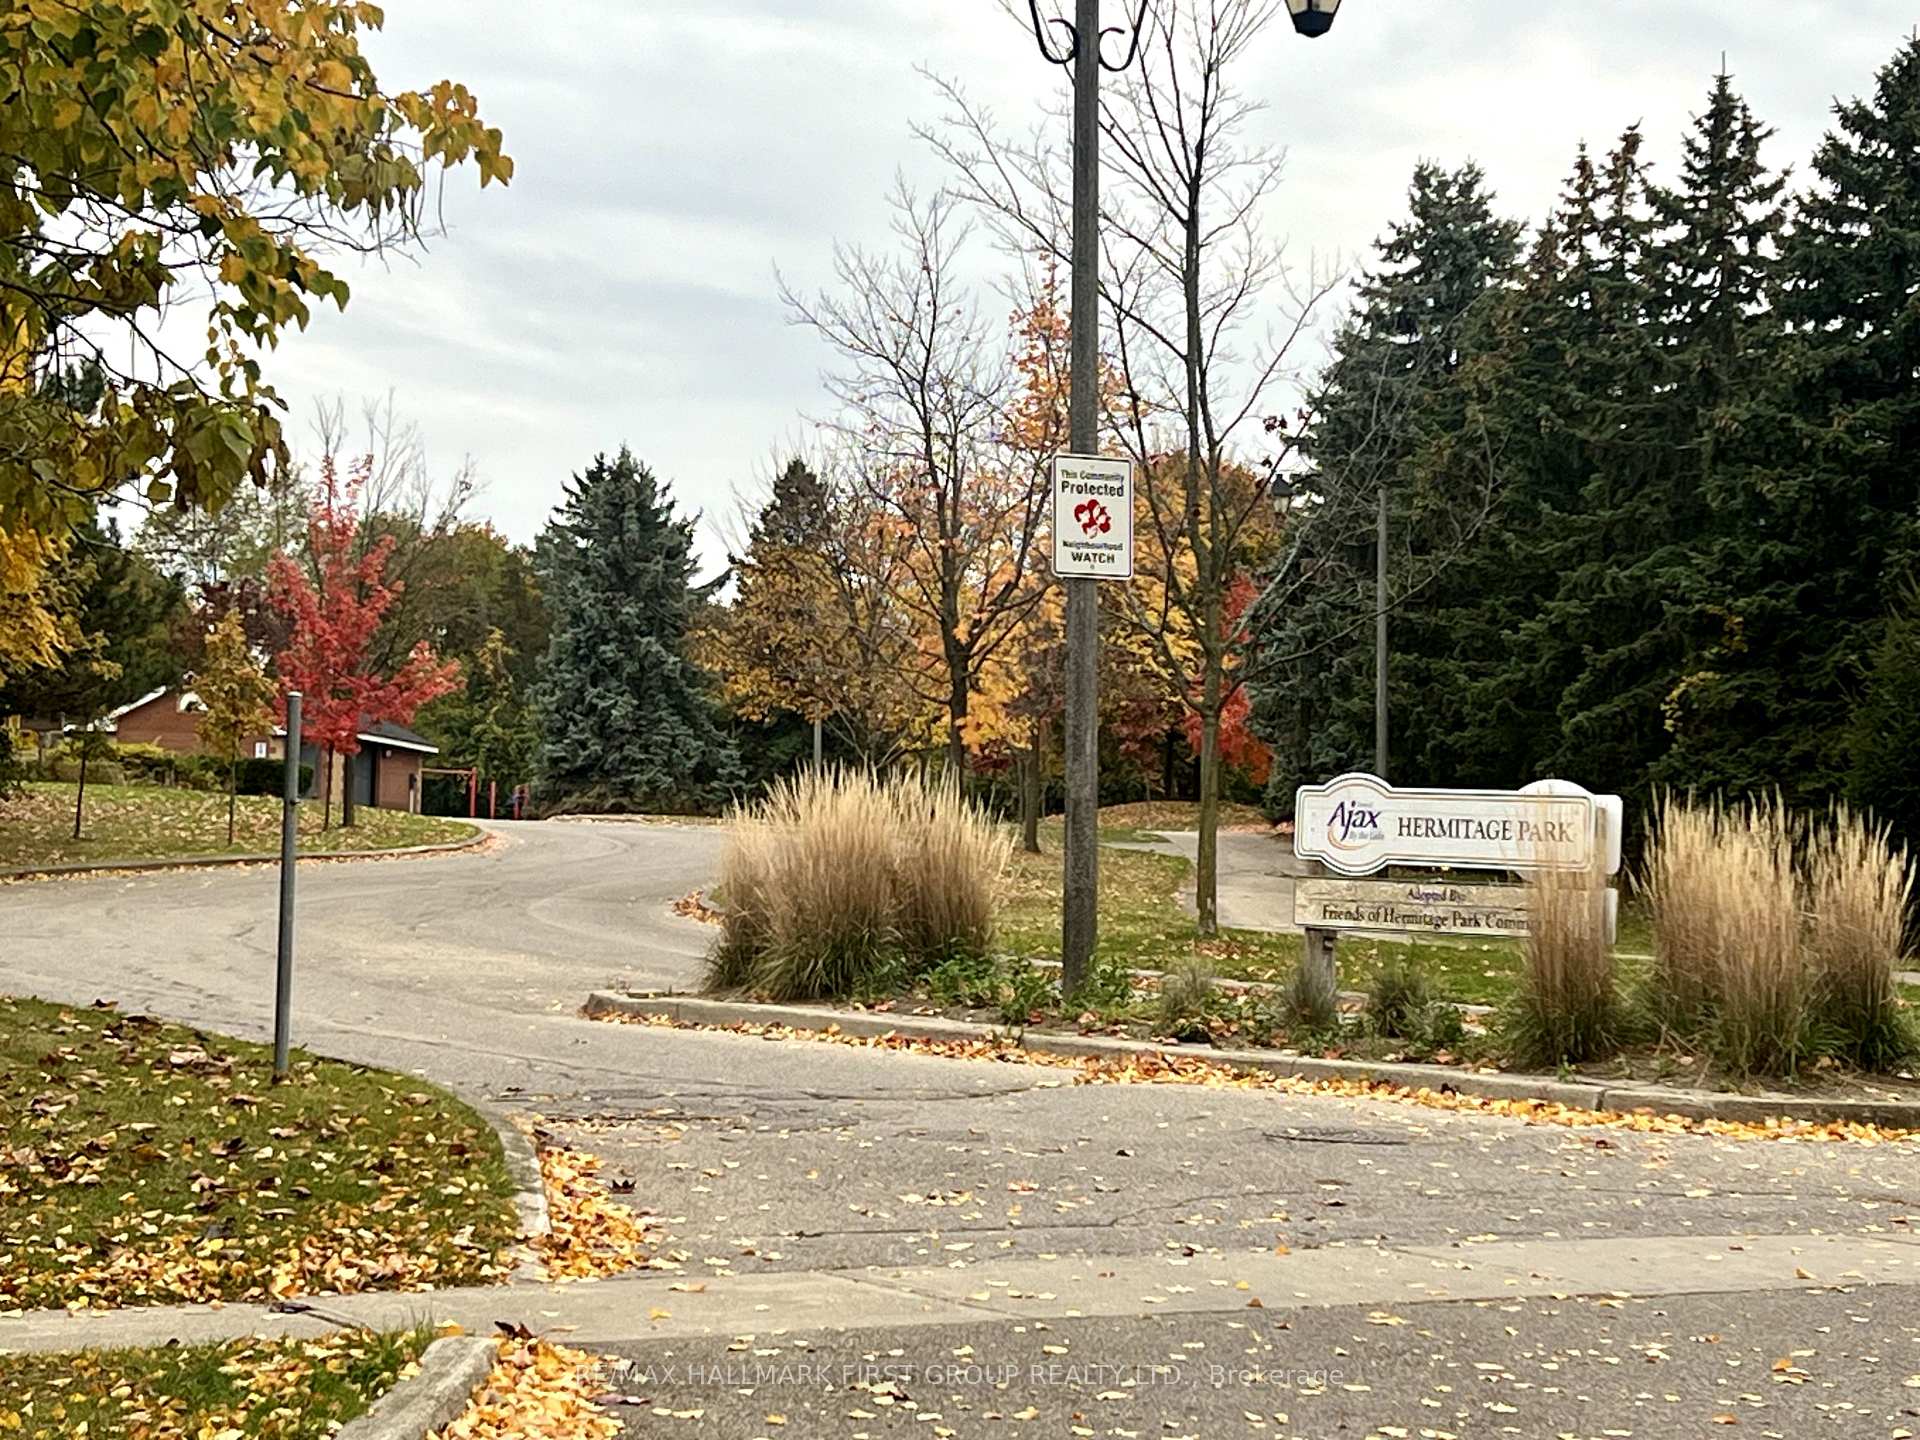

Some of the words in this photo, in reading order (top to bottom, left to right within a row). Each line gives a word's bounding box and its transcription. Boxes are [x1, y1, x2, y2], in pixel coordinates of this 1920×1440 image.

[1061, 480, 1124, 497] Protected
[1071, 552, 1115, 563] WATCH
[1327, 800, 1382, 842] Ajax
[1397, 817, 1512, 841] HERMITAGE
[1517, 820, 1575, 843] PARK
[1322, 903, 1365, 921] Friends
[1367, 905, 1381, 922] of
[1383, 906, 1449, 929] Hermitage
[1451, 910, 1481, 928] Park
